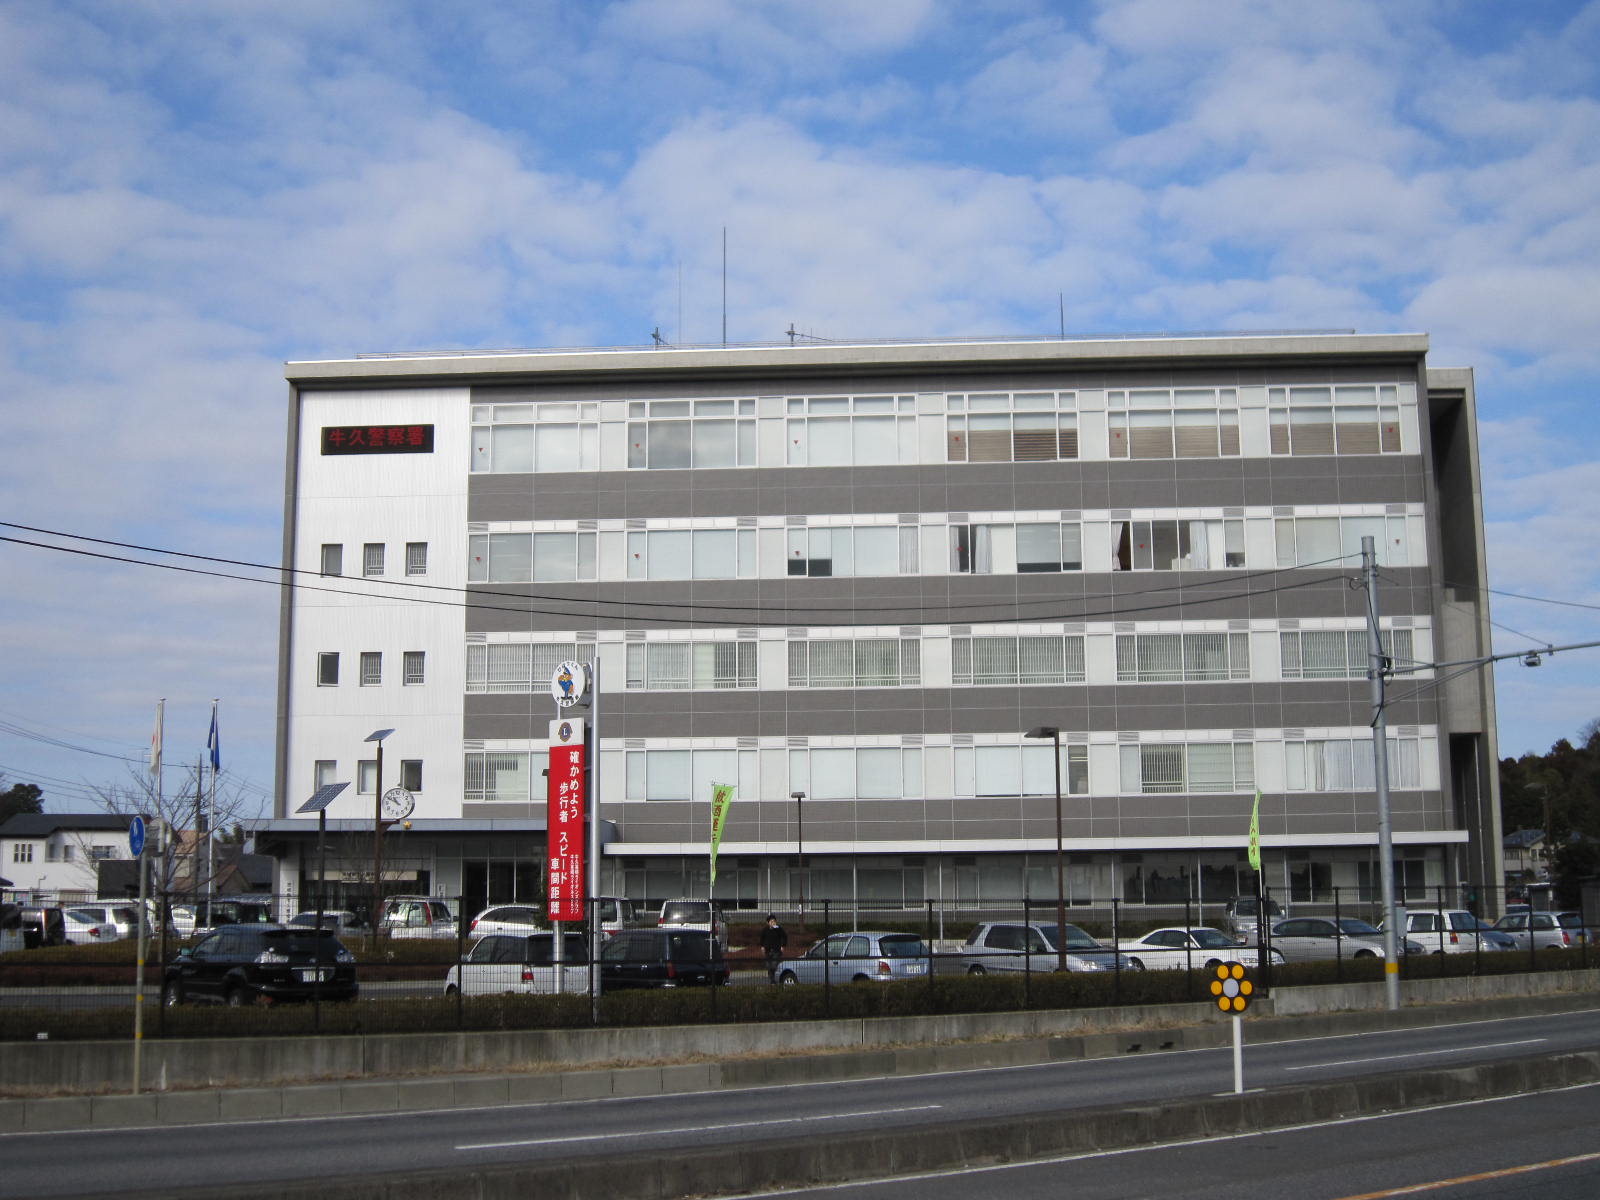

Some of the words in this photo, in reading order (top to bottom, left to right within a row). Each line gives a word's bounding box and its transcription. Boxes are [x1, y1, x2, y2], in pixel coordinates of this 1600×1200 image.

[329, 427, 425, 446] 牛久警察署
[559, 782, 569, 823] 歩行者
[569, 751, 580, 819] 確かめよう
[559, 832, 569, 885] スピード
[550, 858, 560, 914] 車間距離
